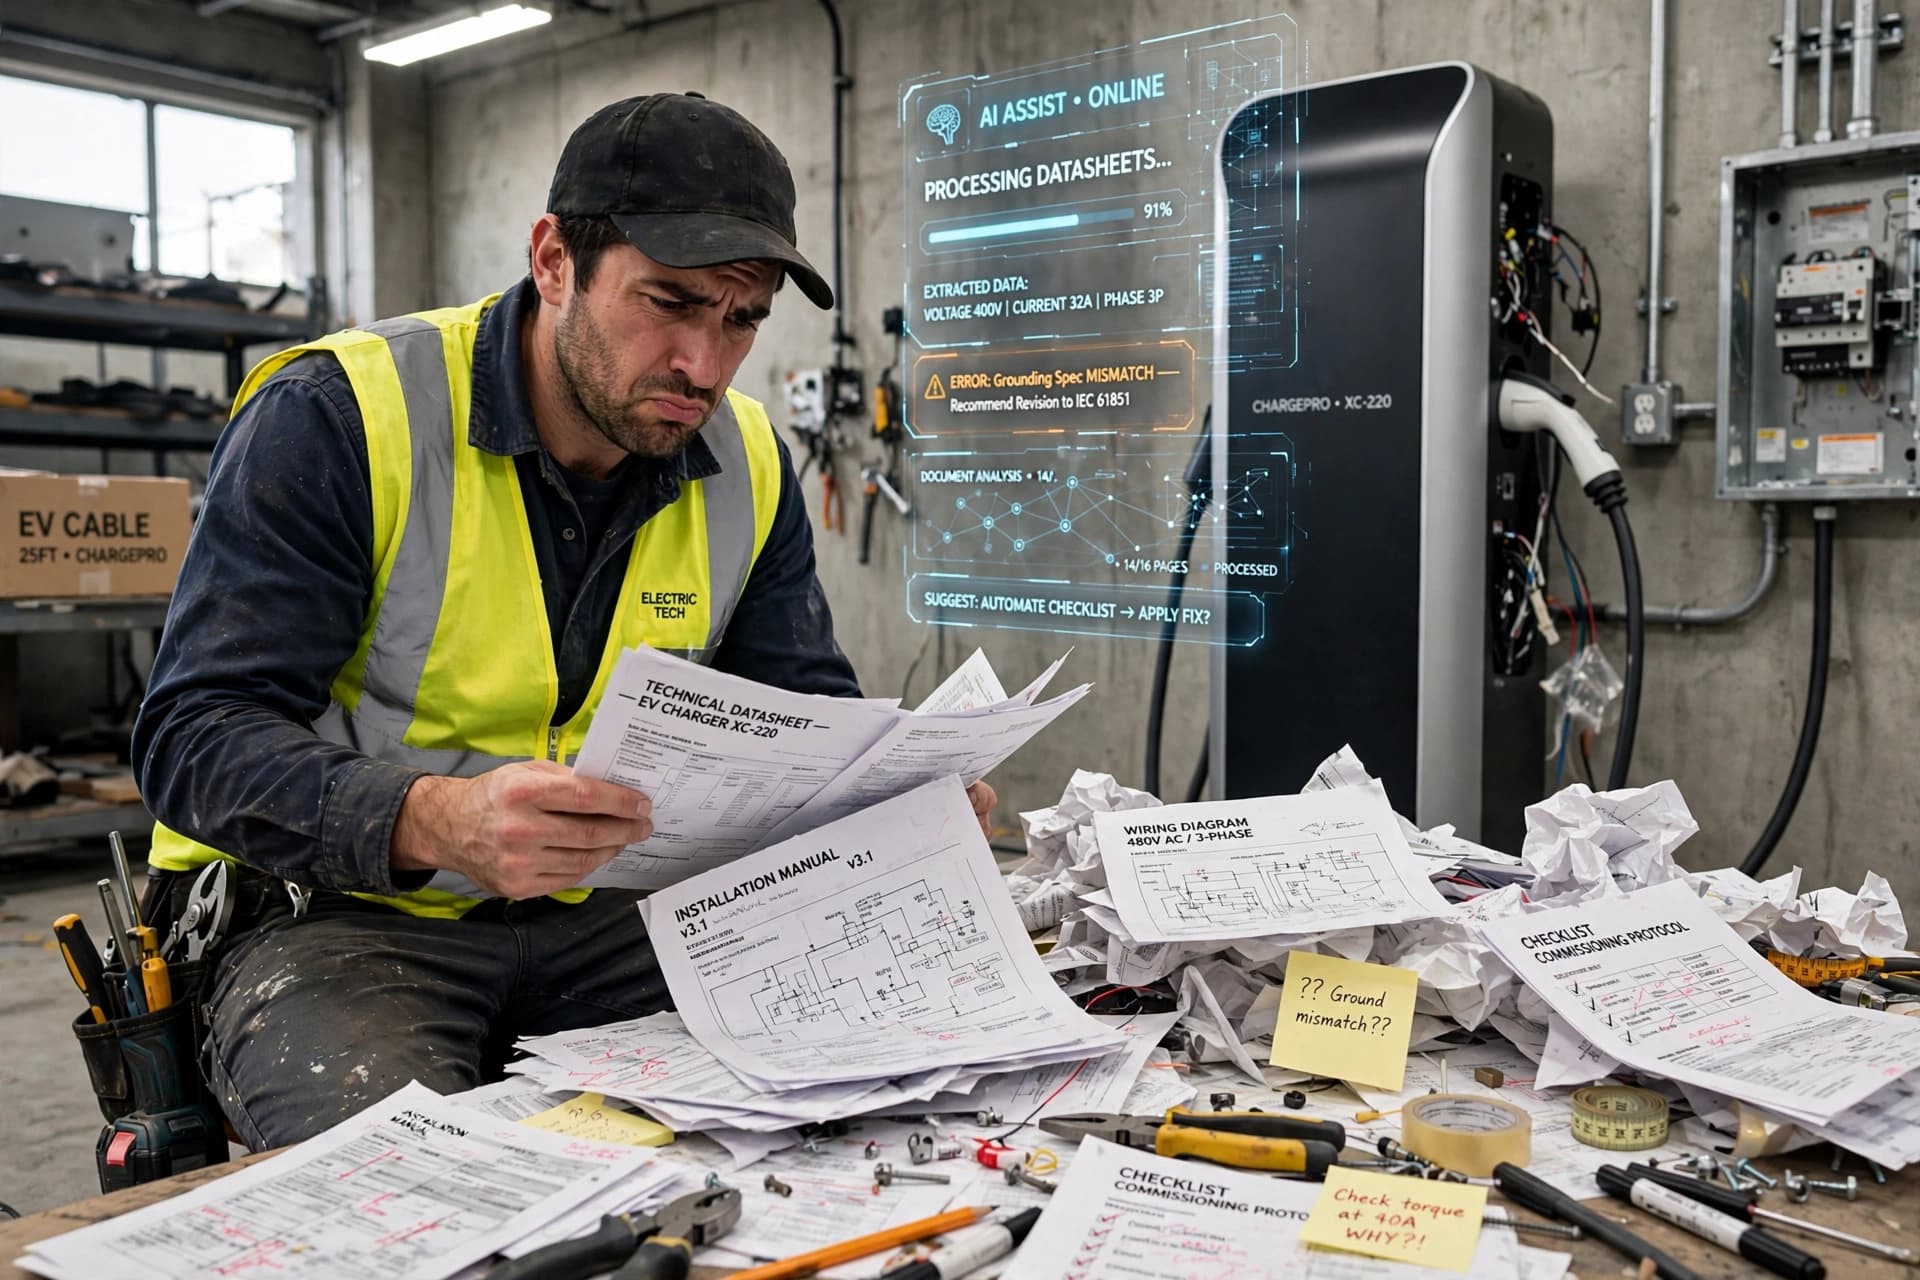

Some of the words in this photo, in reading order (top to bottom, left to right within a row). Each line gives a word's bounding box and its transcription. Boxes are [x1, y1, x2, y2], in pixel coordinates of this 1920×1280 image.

[979, 105, 998, 128] AI
[1002, 91, 1067, 125] ASSIST
[1088, 73, 1165, 108] ONLINE
[924, 164, 1032, 202] PROCESSING
[1036, 147, 1172, 187] DATASHEETS...
[1143, 201, 1172, 219] 91%
[923, 280, 989, 300] EXTRACTED
[993, 276, 1028, 294] DATA:
[924, 304, 972, 322] VOLTAGE
[974, 302, 1003, 319] 400V
[1013, 296, 1067, 315] CURRENT
[1069, 294, 1093, 310] 32A
[1104, 290, 1145, 308] PHASE
[1147, 288, 1164, 304] 3P
[950, 373, 991, 389] ERROR:
[993, 370, 1053, 391] Grounding
[1055, 368, 1083, 388] Spec
[1086, 365, 1154, 383] MISMATCH
[950, 396, 1013, 413] Recommend
[1016, 395, 1058, 411] Revision
[1061, 395, 1073, 408] to
[1075, 393, 1094, 408] IEC
[1097, 391, 1130, 407] 61851
[1252, 397, 1331, 413] CHARGEPRO
[1344, 393, 1392, 410] XC-220
[921, 470, 974, 483] DOCUMENT
[976, 470, 1022, 483] ANALYSIS
[19, 511, 55, 538] EV
[63, 512, 150, 538] CABLE
[19, 546, 58, 564] 25FT
[76, 546, 168, 564] CHARGEPRO
[1124, 559, 1152, 573] 14/16
[1154, 560, 1188, 574] PAGES
[1214, 562, 1278, 576] PROCESSED
[641, 592, 697, 605] ELECTRIC
[924, 591, 979, 610] SUGGEST:
[980, 595, 1046, 614] AUTOMATE
[1048, 600, 1116, 618] CHECKLIST
[1138, 605, 1179, 623] APPLY
[1182, 608, 1211, 625] FIX?
[654, 607, 685, 619] TECH
[638, 695, 658, 711] EV
[660, 700, 728, 731] CHARGER
[730, 721, 779, 739] XC-220
[646, 679, 726, 714] TECHNICAL
[729, 703, 813, 731] DATASHEET
[1123, 823, 1177, 835] WIRING
[1181, 817, 1249, 832] DIAGRAM
[1127, 835, 1161, 847] 480V
[1165, 834, 1184, 845] AC
[1196, 828, 1254, 842] 3-PHASE
[674, 871, 777, 923] INSTALLATION
[778, 848, 840, 882] MANUAL
[846, 850, 874, 870] v3.1
[680, 918, 708, 939] v3.1
[1520, 923, 1595, 950] CHECKLIST
[1534, 934, 1630, 964] COMMISSIONING
[1626, 921, 1690, 944] PROTOCOL
[1300, 977, 1325, 1001] ??
[1330, 985, 1386, 1008] Ground
[1119, 1166, 1231, 1197] CHECKLIST
[1114, 1180, 1249, 1213] COMMISSIONING
[1334, 1187, 1390, 1207] Check
[1401, 1197, 1465, 1220] torque
[1338, 1209, 1362, 1221] at
[1375, 1211, 1416, 1229] 40A
